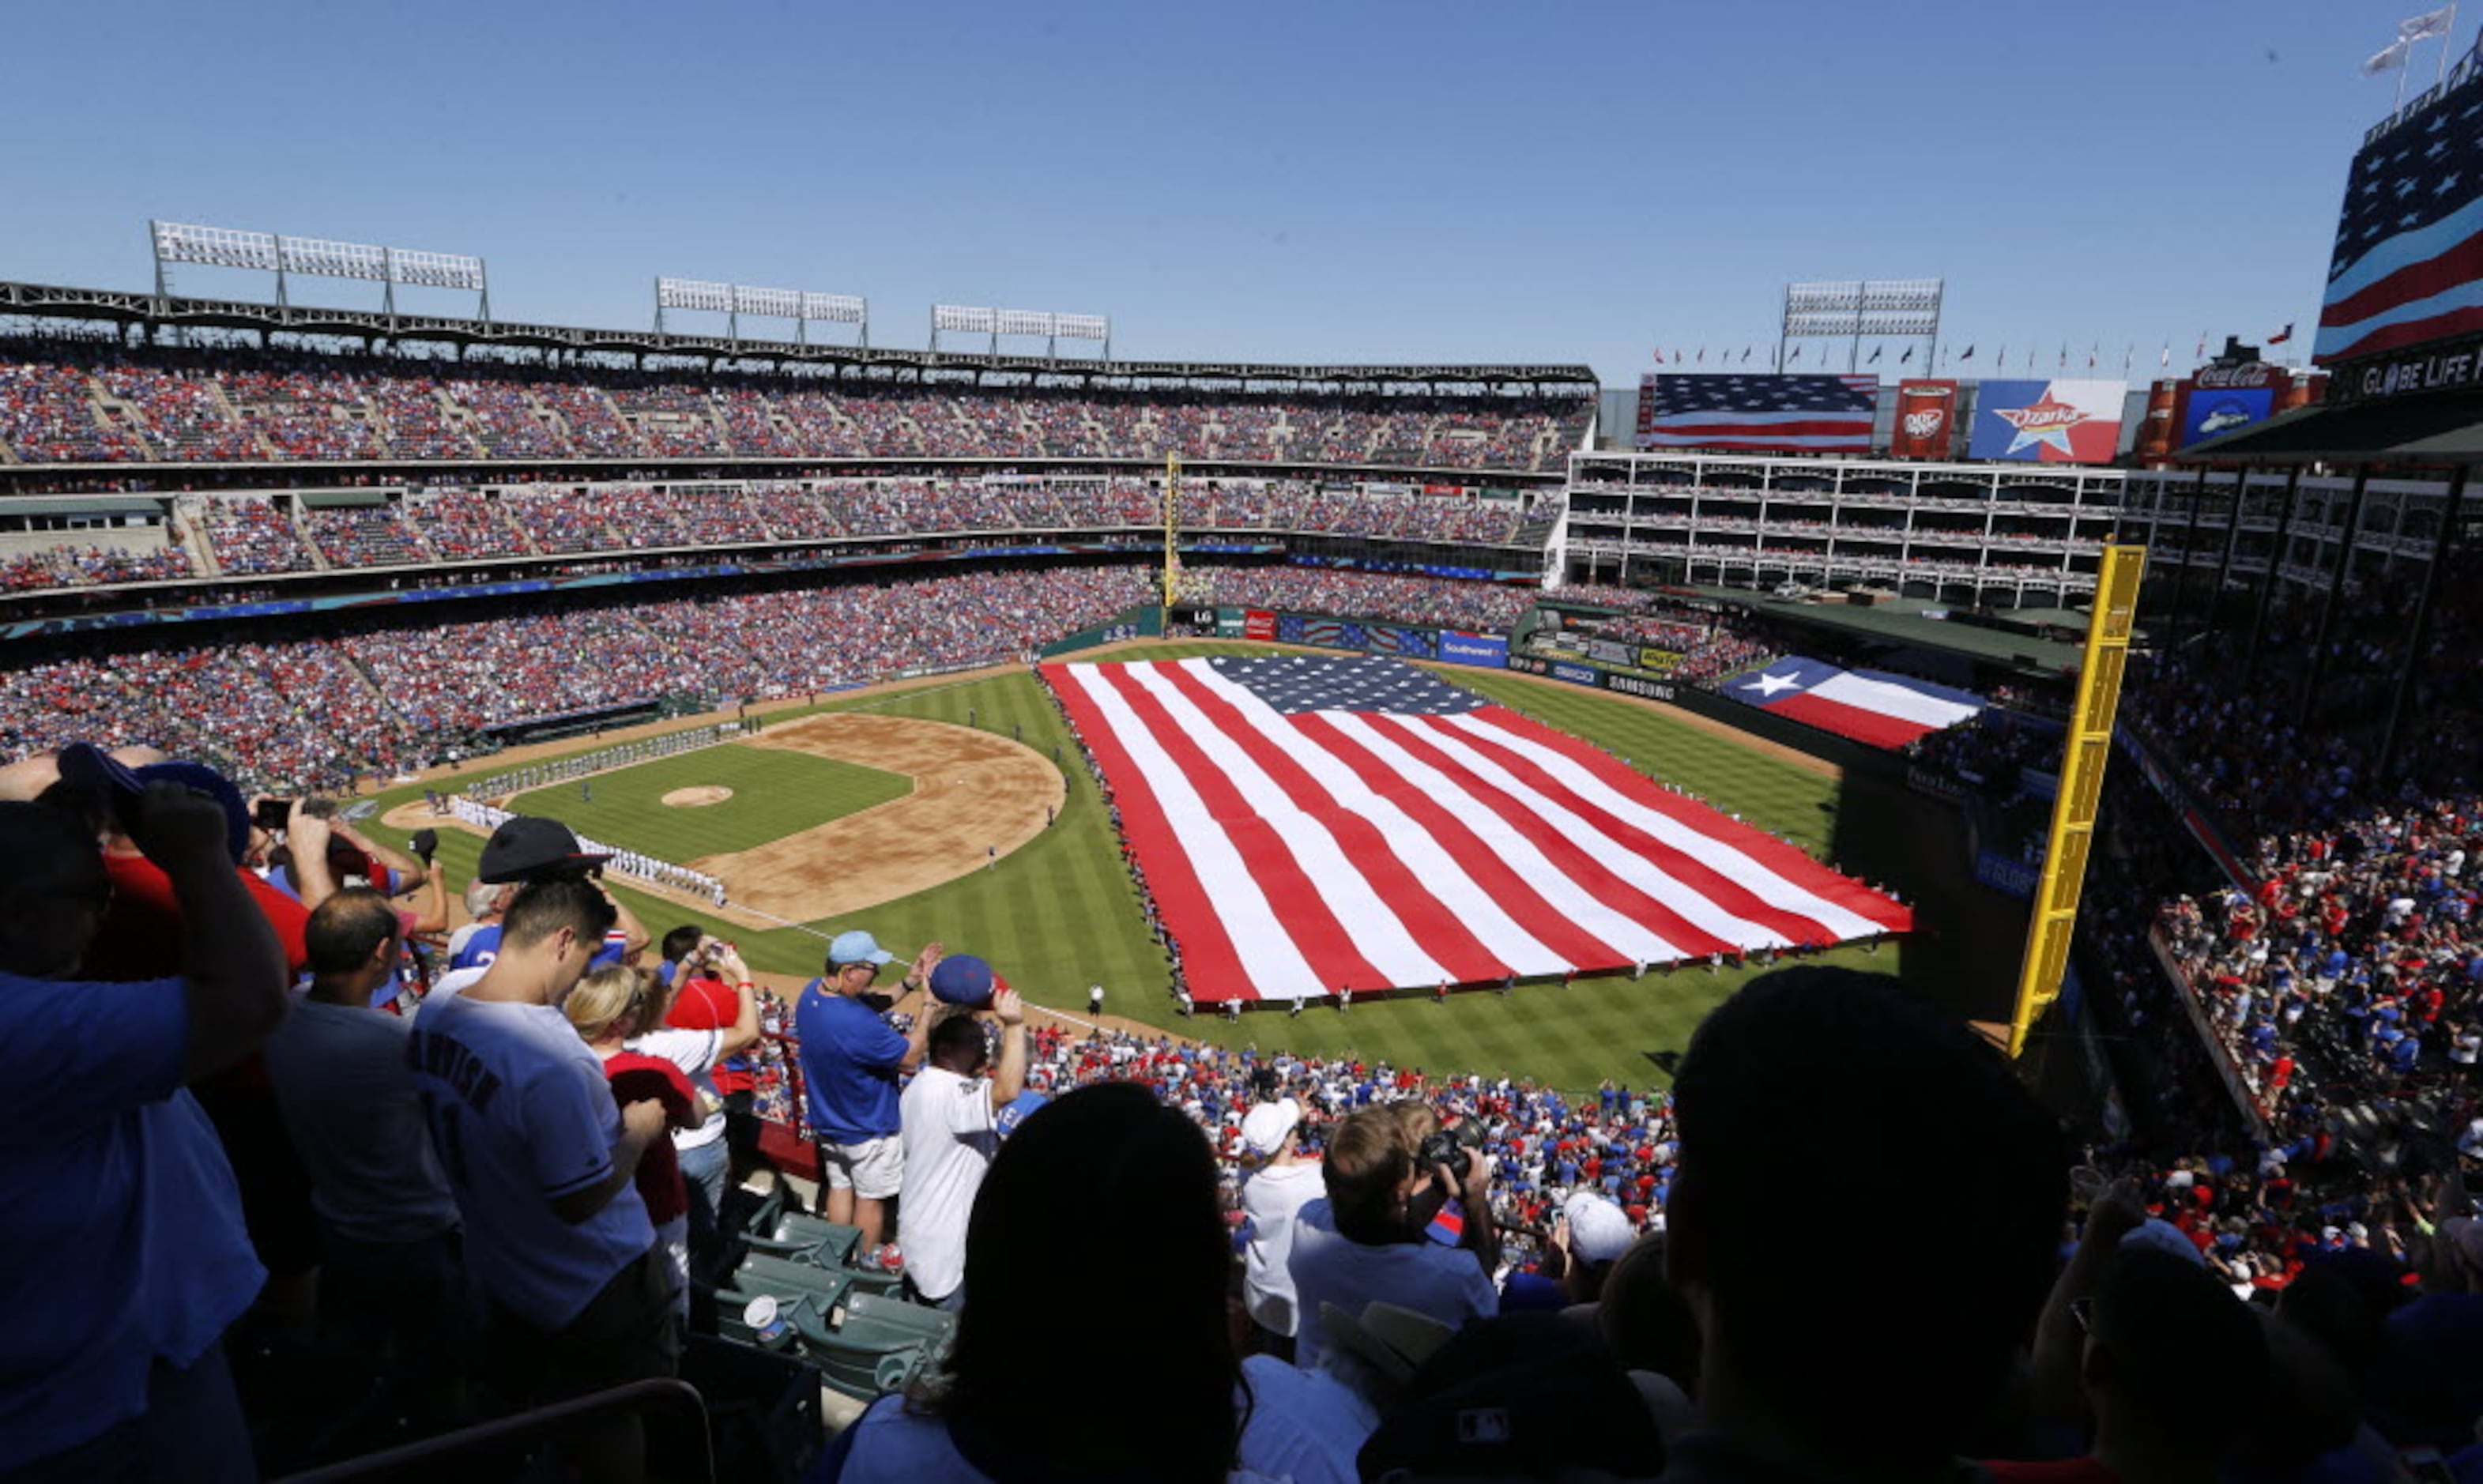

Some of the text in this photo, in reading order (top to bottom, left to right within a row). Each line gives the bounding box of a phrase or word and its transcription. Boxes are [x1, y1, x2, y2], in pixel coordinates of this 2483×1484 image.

[2362, 362, 2424, 395] GLOBE
[2424, 353, 2473, 387] LIFE
[2015, 407, 2080, 427] Ozarka
[1193, 610, 1212, 623] LG
[1444, 642, 1493, 657] Southwest
[1608, 675, 1675, 700] SAMSUNG
